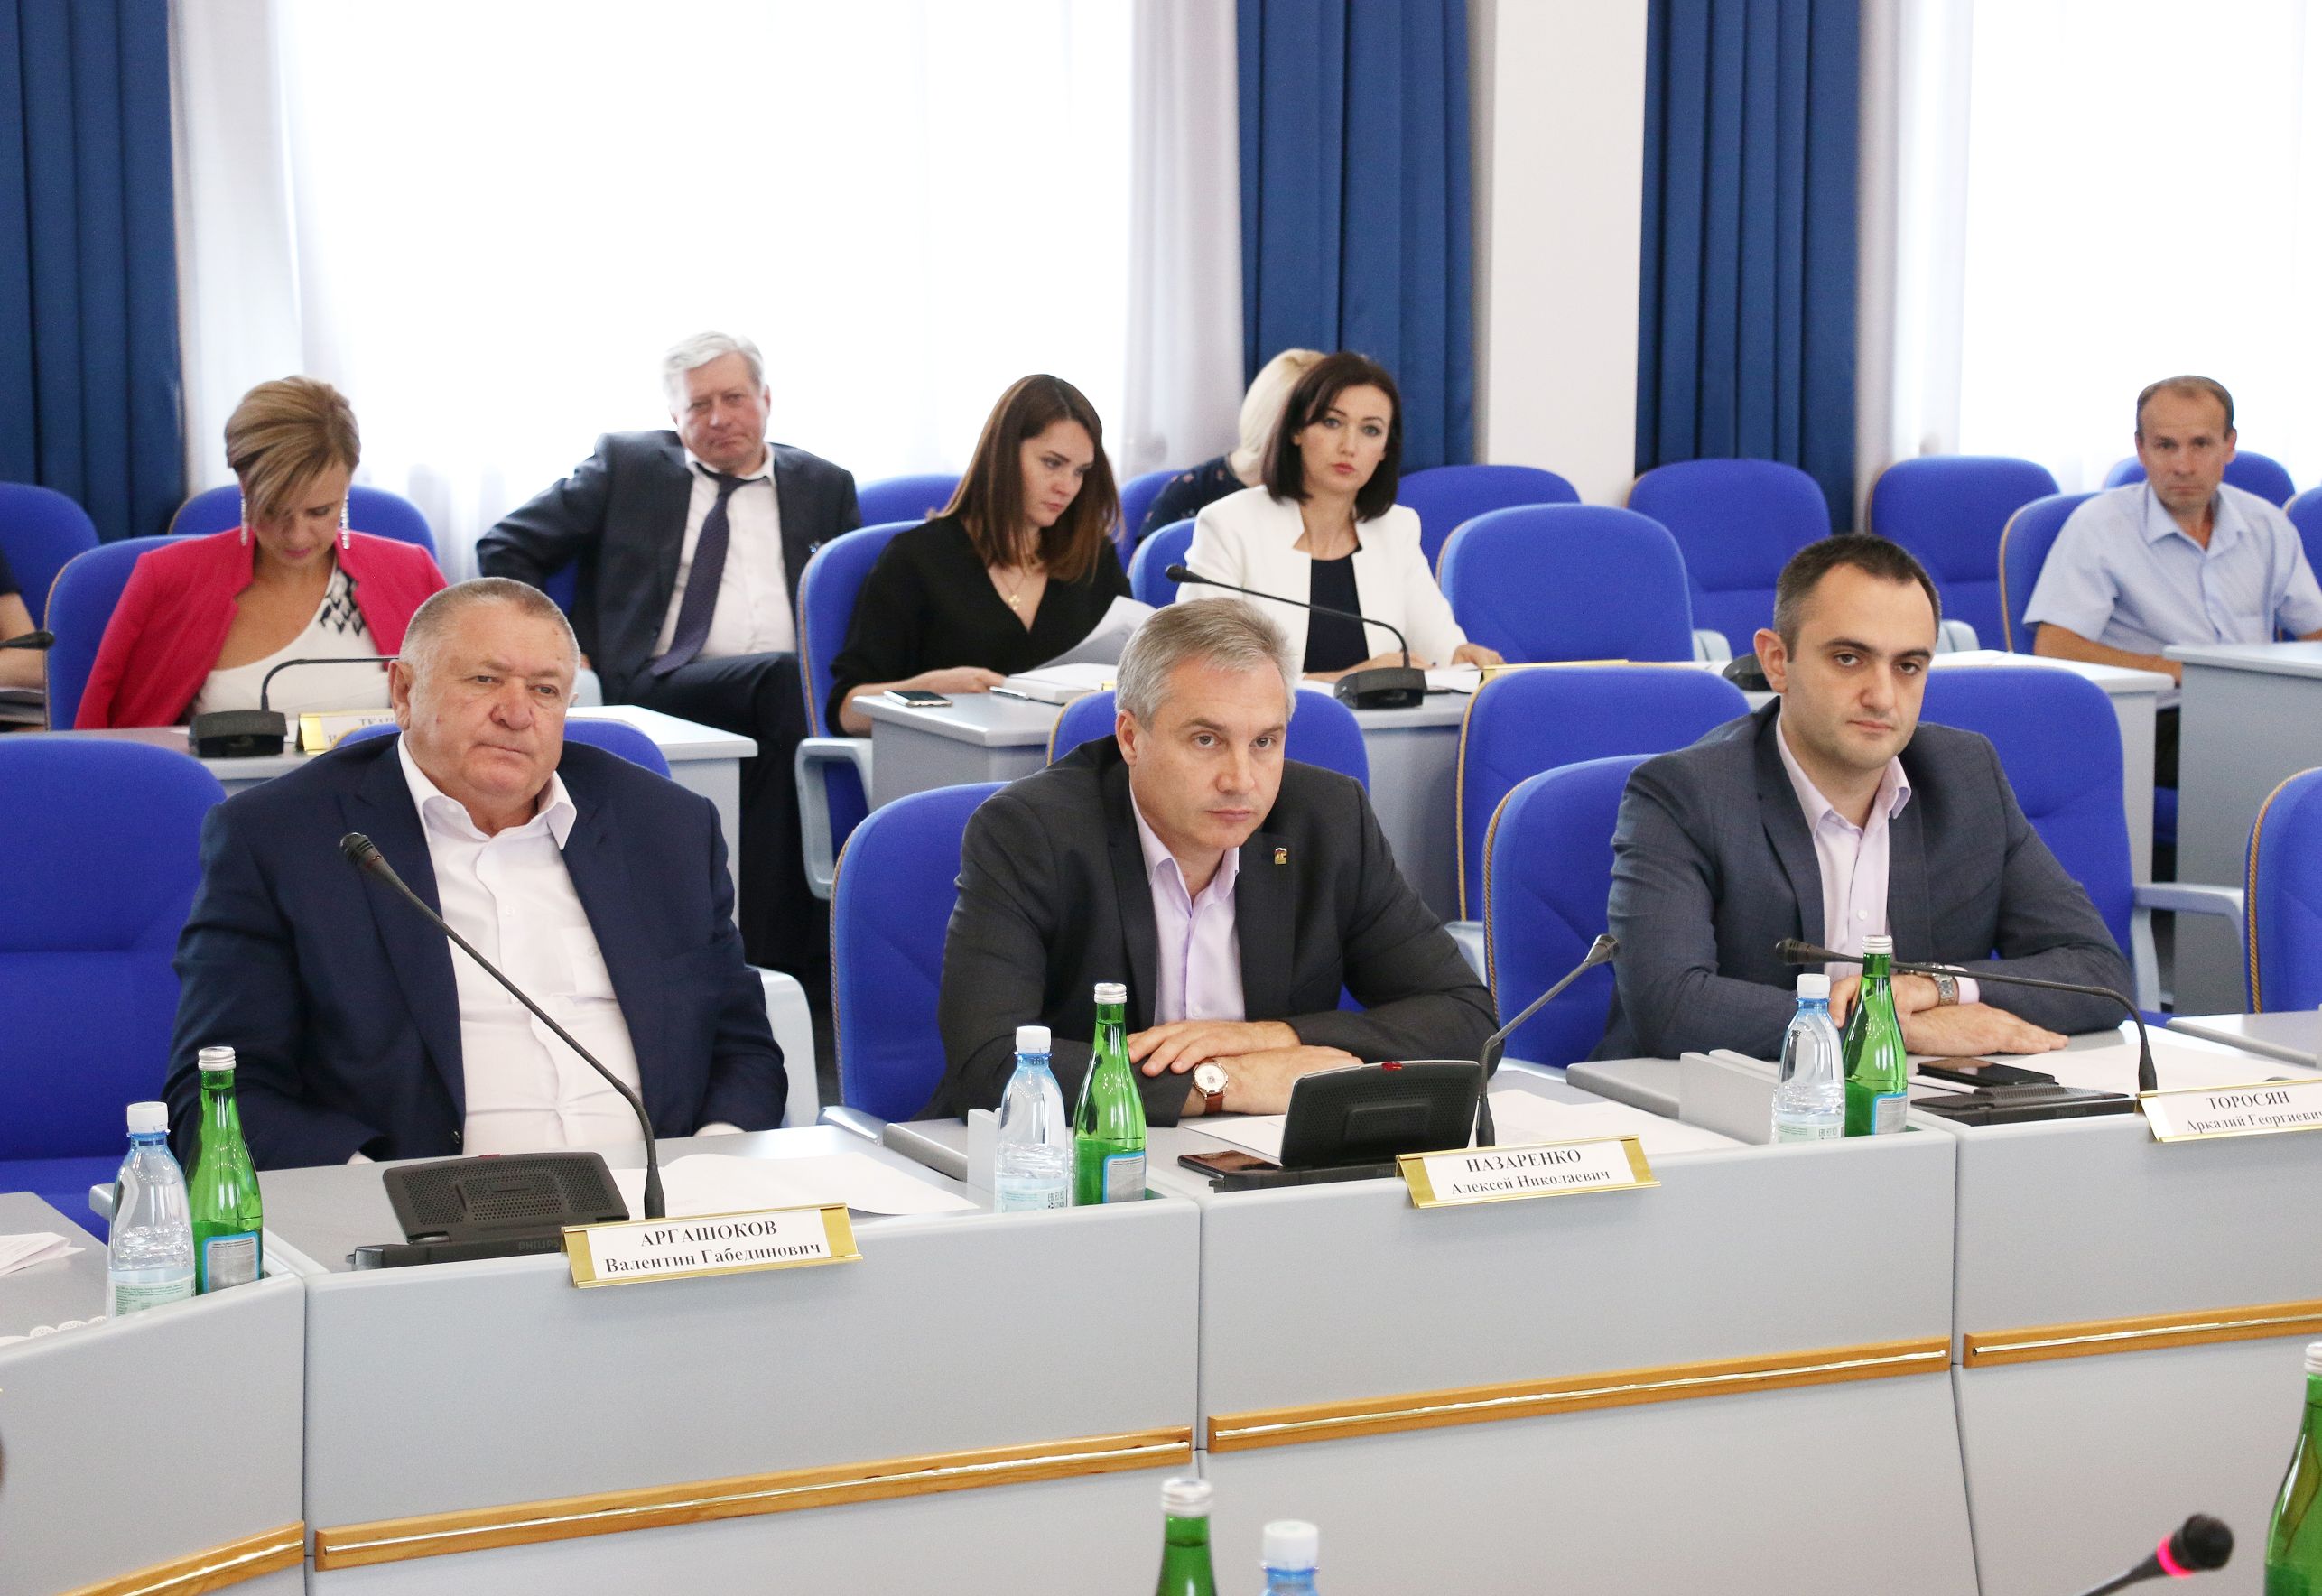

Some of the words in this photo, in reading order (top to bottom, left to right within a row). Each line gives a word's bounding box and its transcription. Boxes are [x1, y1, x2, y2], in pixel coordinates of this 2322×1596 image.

[2206, 1090, 2290, 1110] ТОРОСЯН
[2187, 1115, 2245, 1134] Аркадий
[1465, 1149, 1582, 1173] НАЗАРЕНКО
[1452, 1176, 1514, 1195] Алексей
[1517, 1170, 1611, 1188] Николаевич
[641, 1220, 777, 1247] АРГАШОКОВ
[606, 1255, 696, 1273] Валентин
[701, 1243, 821, 1264] Габединович
